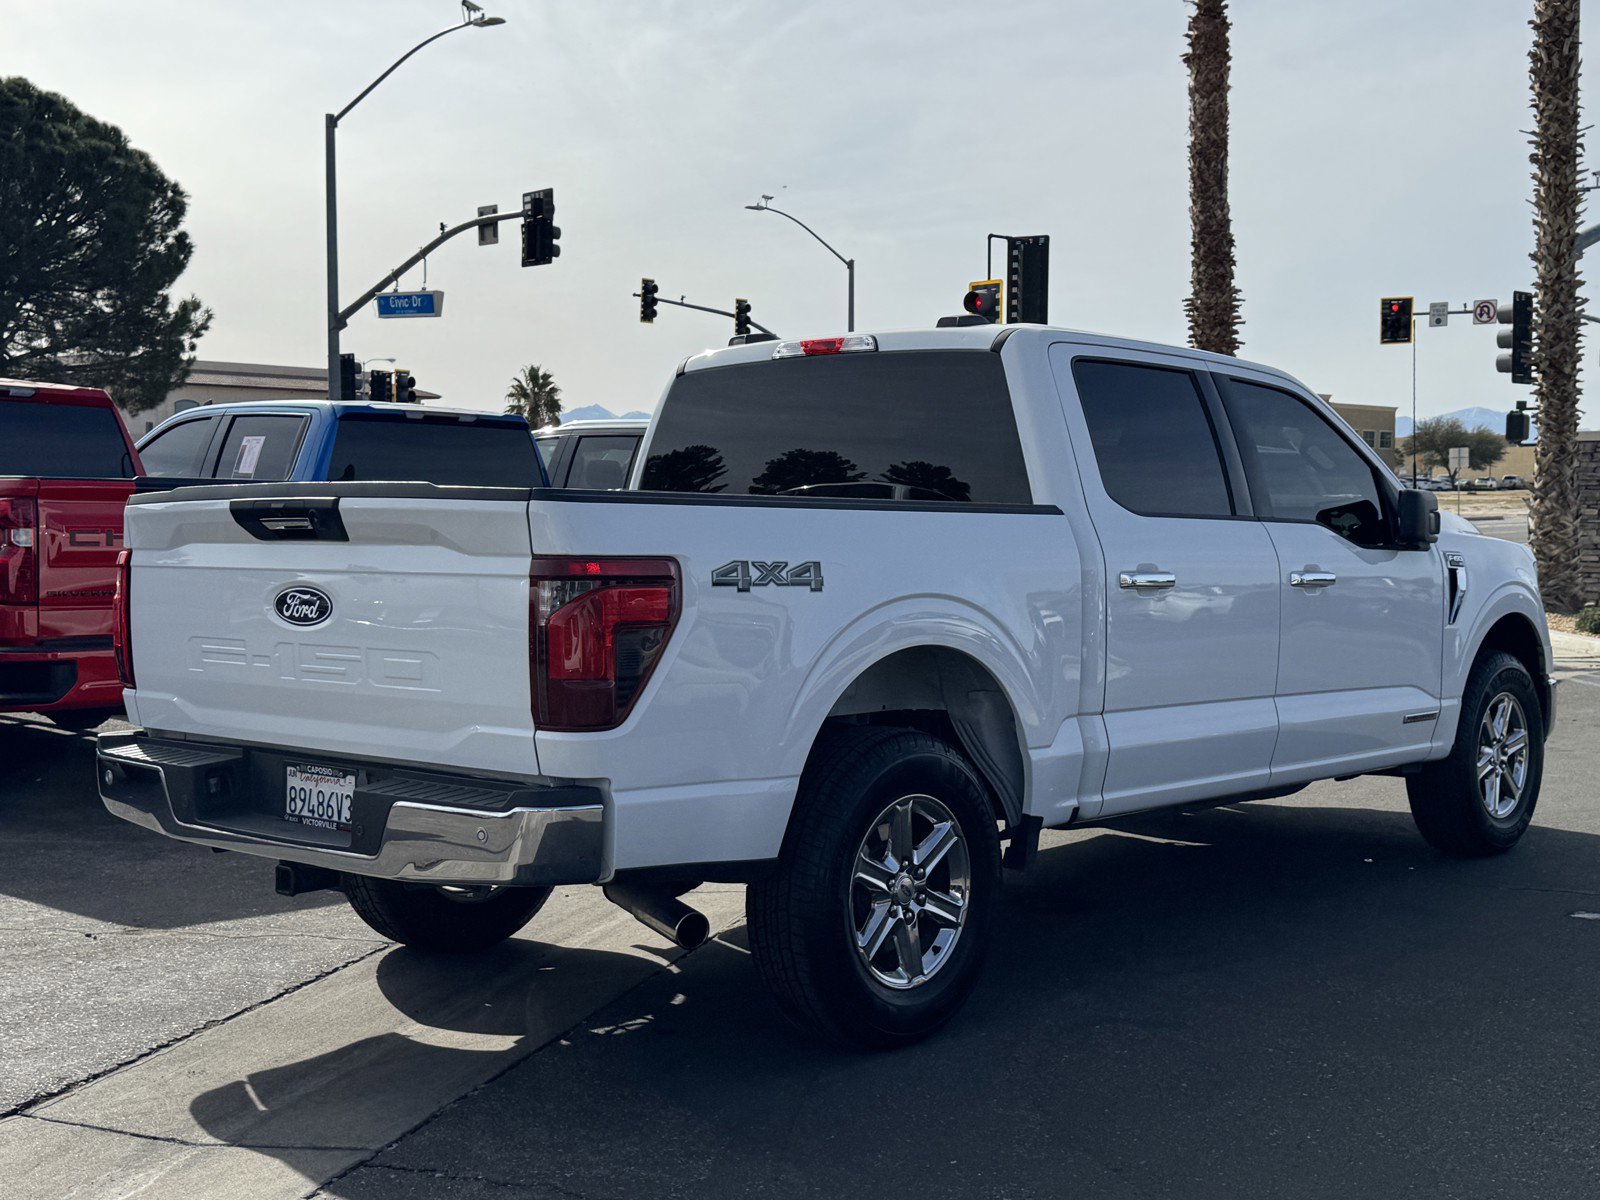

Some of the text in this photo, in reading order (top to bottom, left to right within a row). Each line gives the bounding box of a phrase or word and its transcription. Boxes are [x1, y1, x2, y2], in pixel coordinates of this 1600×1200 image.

[389, 295, 422, 308] Civic Dr
[283, 592, 320, 619] Ford
[288, 786, 353, 822] 89486V3
[302, 817, 337, 830] VICTORVILLE
